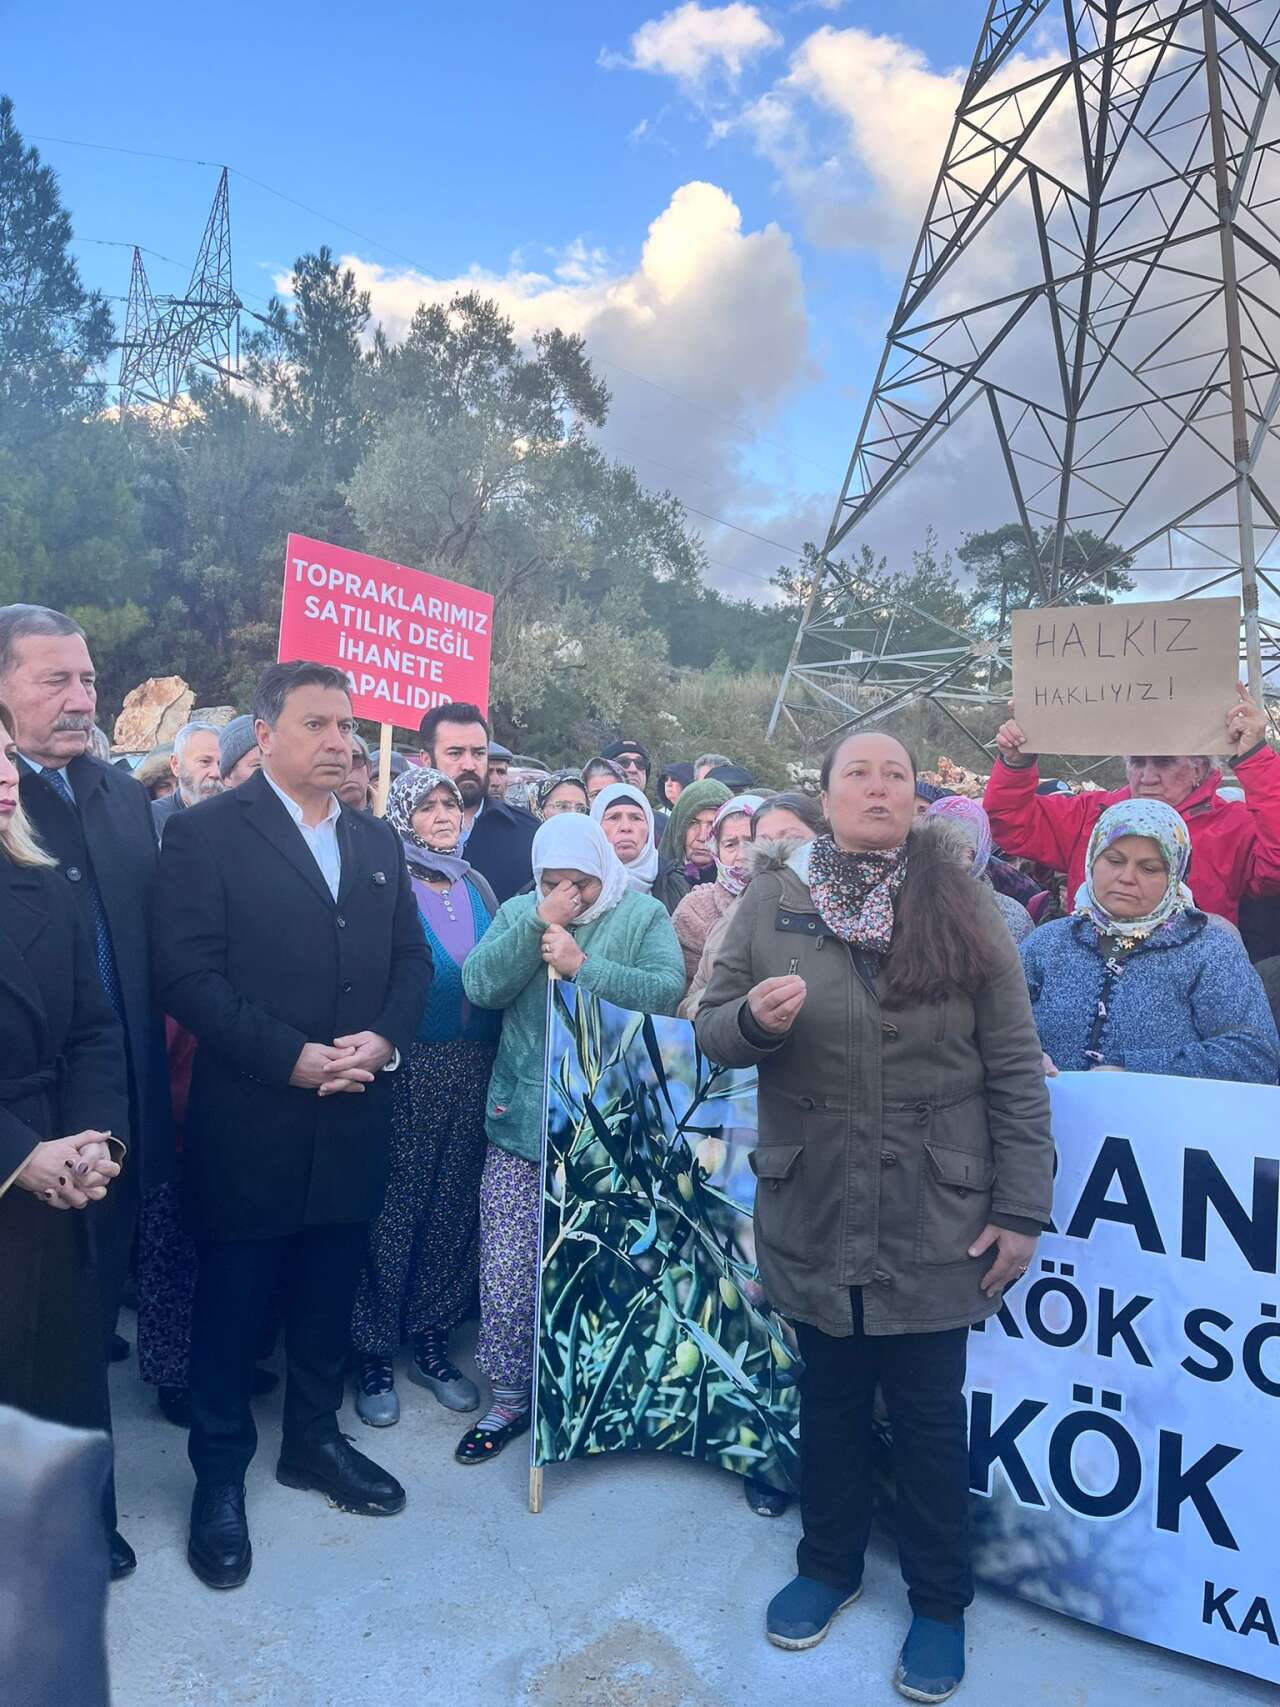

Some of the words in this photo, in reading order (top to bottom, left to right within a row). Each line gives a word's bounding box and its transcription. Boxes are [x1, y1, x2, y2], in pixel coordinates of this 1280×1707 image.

[292, 558, 489, 635] TOPRAKLARIMIZ
[304, 595, 403, 640] SATILIK
[408, 623, 475, 661] DEĞİL
[338, 632, 444, 683] İHANETE
[1035, 617, 1199, 659] HALKIZ
[345, 670, 453, 709] APALIDI
[1041, 1135, 1280, 1274] AN
[968, 1383, 1244, 1552] KÖK
[1201, 1579, 1280, 1646] KA
